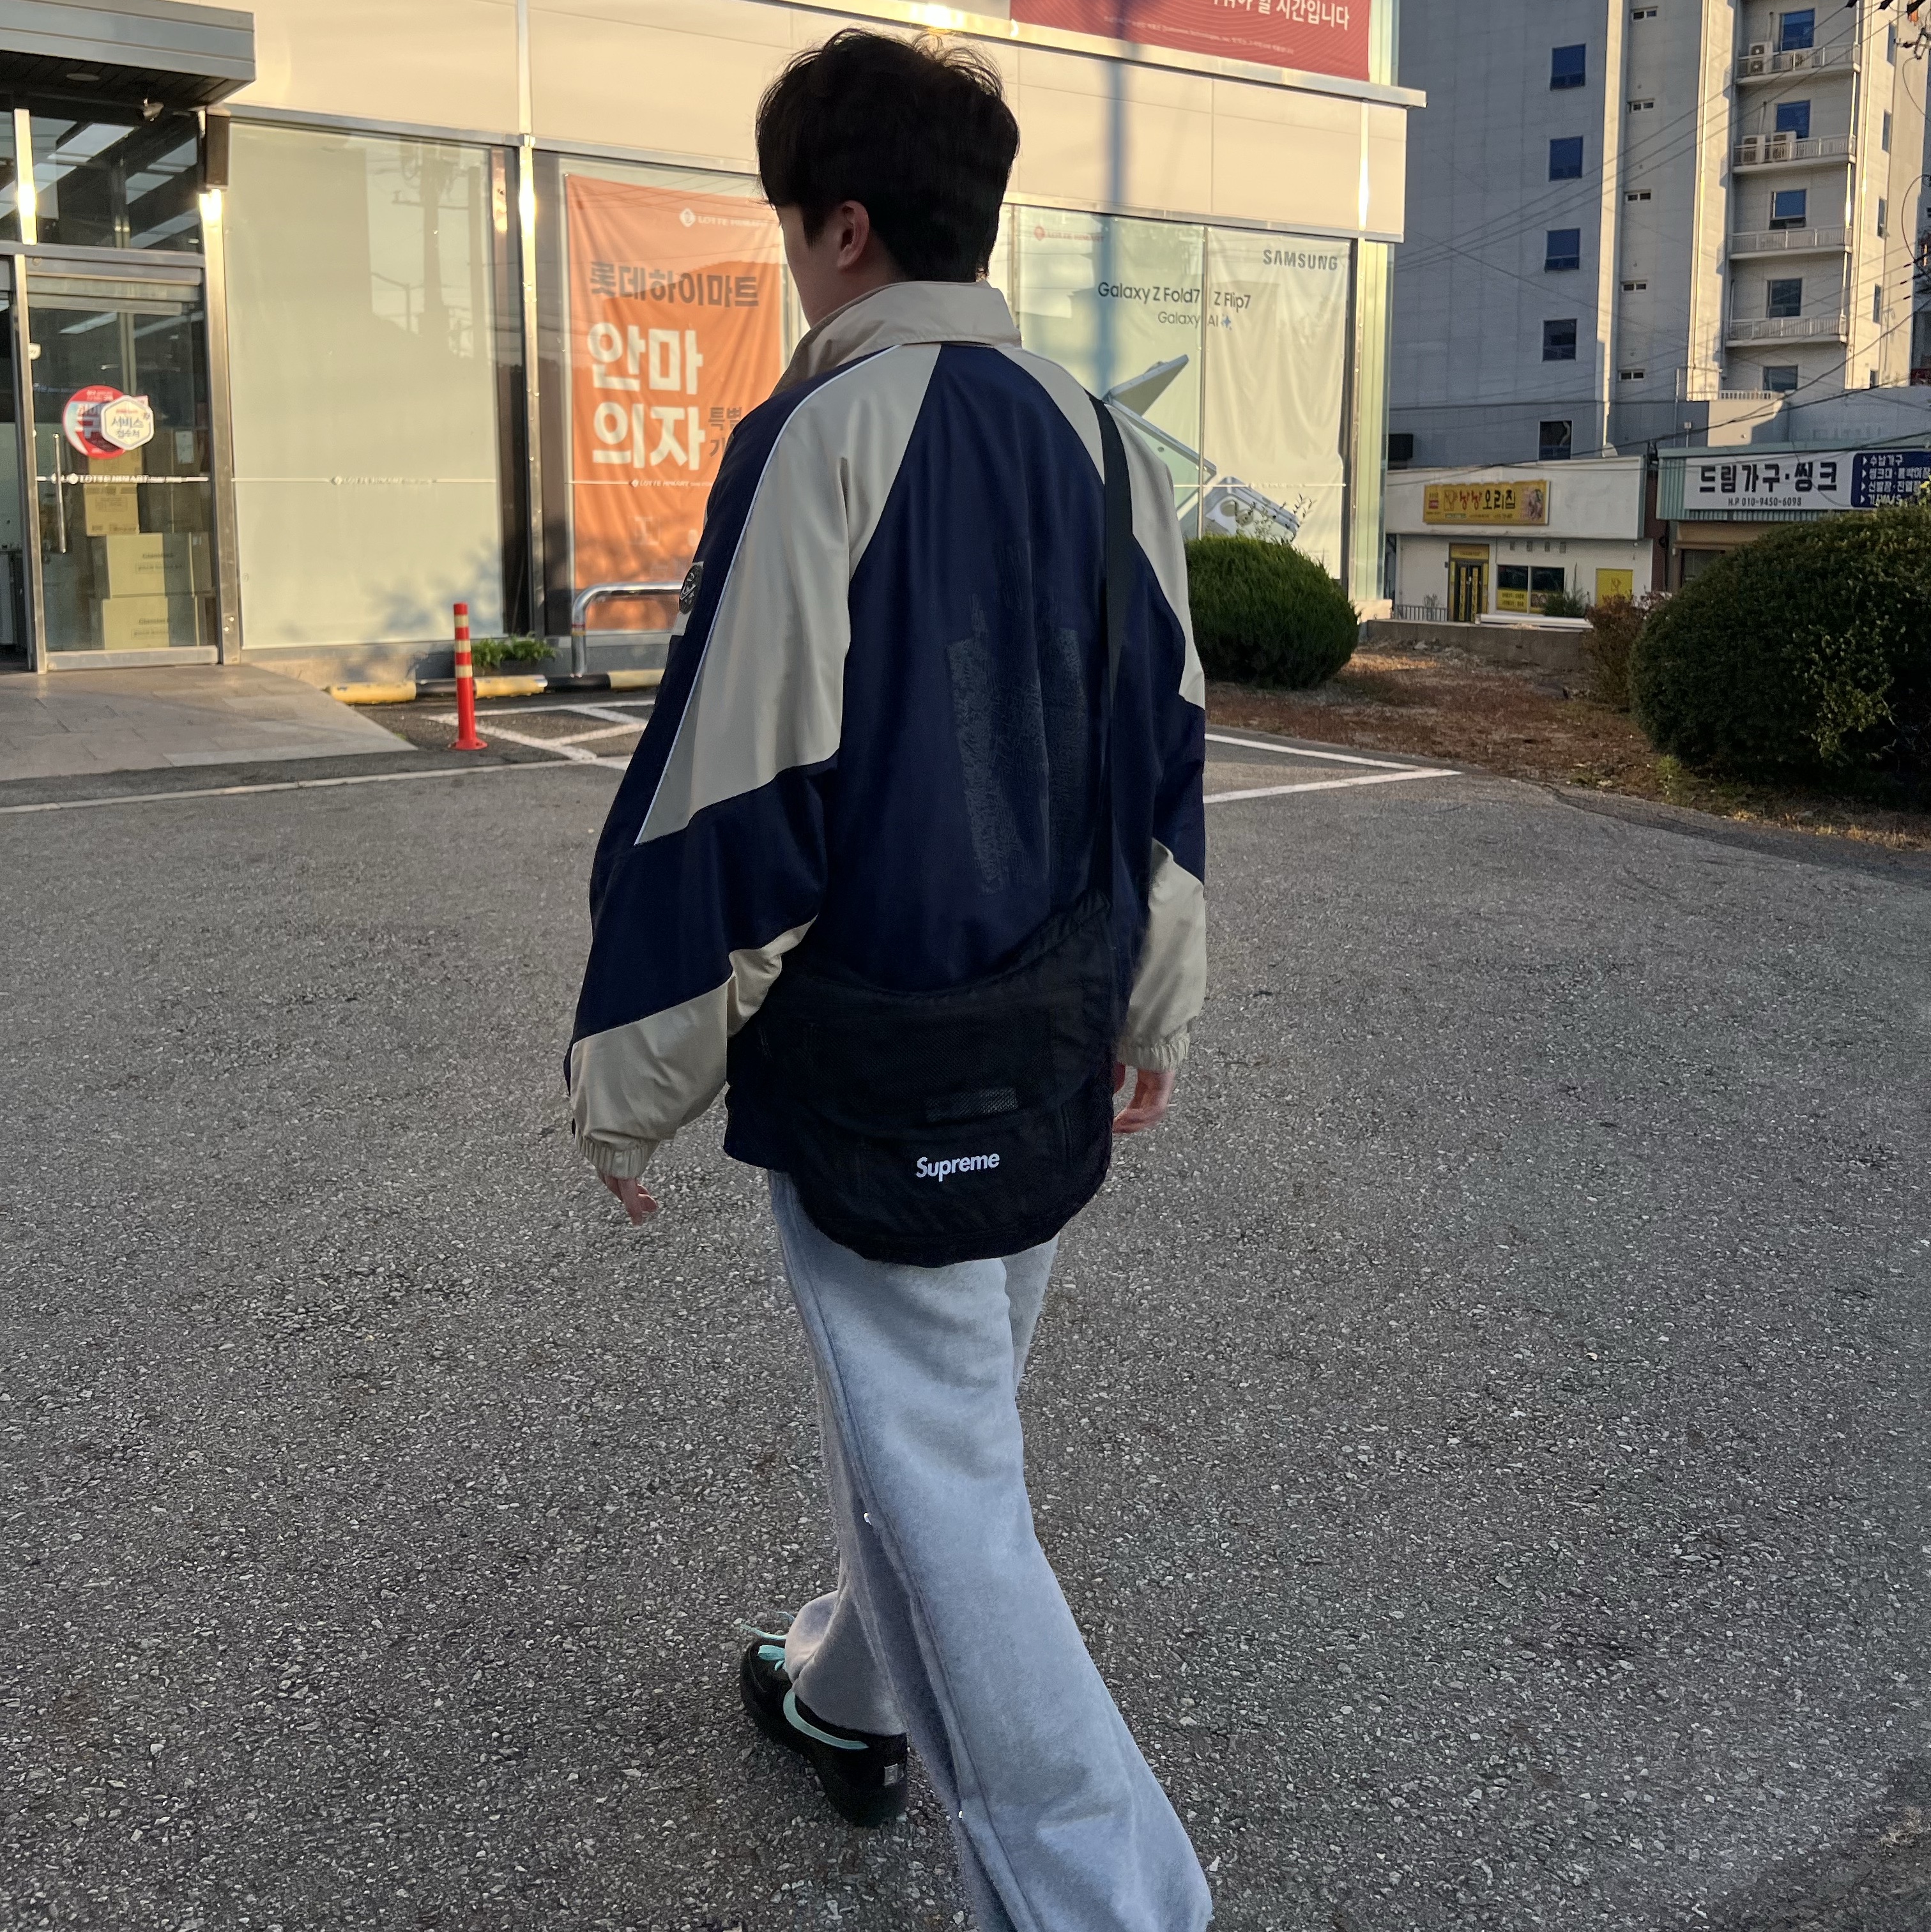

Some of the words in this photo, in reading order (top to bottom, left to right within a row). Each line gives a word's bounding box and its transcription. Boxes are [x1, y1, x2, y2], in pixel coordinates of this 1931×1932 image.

[1276, 0, 1350, 31] 시간입니다
[1263, 249, 1338, 271] SAMSUNG
[590, 261, 759, 308] 롯데하이마트
[1097, 282, 1150, 304] Galaxy
[1153, 286, 1161, 302] Z
[1164, 286, 1200, 304] Fold7
[1214, 291, 1221, 306] Z
[1224, 291, 1251, 313] Flip7
[1157, 311, 1200, 328] Galaxy
[1207, 315, 1219, 327] AI
[587, 322, 703, 395] 안마
[111, 416, 144, 429] 서비스
[593, 402, 705, 471] 의자
[1870, 454, 1903, 466] 수납가구
[1742, 496, 1802, 506] 010-9450-6098
[916, 1153, 1000, 1182] Supreme
